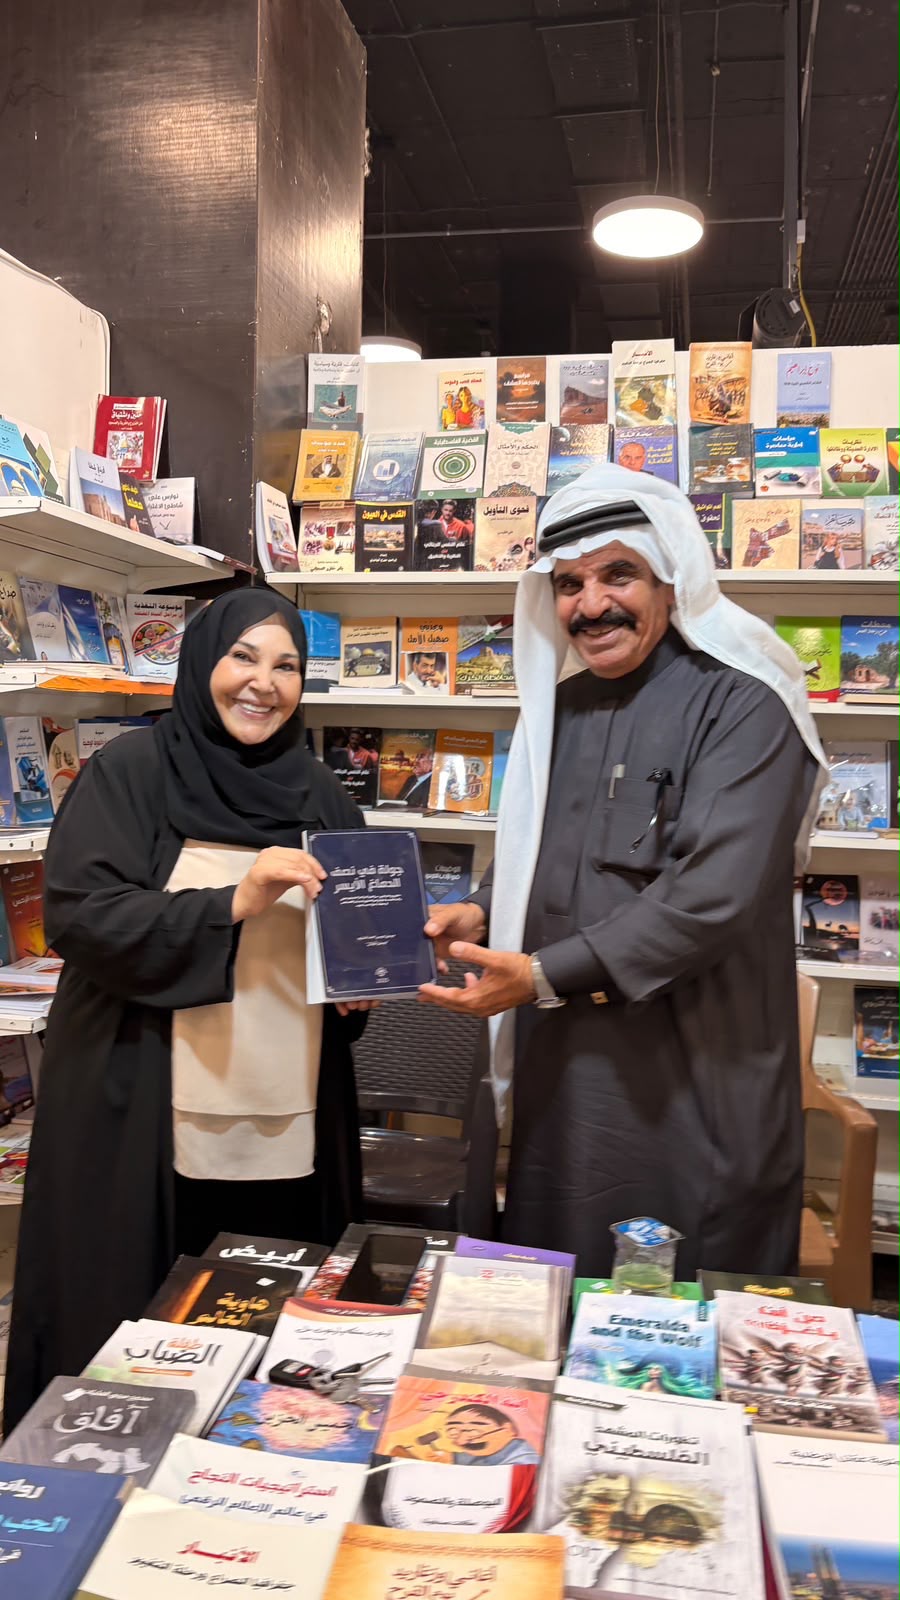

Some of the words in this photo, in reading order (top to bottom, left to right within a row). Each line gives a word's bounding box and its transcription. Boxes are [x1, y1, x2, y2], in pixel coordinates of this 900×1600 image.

[162, 493, 179, 501] نوارس
[362, 510, 379, 519] العيون
[388, 510, 407, 519] القدس
[484, 505, 508, 516] التأويل
[510, 505, 529, 514] فحوى
[134, 601, 157, 610] التغذية
[330, 865, 356, 877] نصف
[357, 866, 377, 880] في
[378, 865, 405, 877] جولة
[333, 878, 366, 894] الأيسر
[368, 879, 402, 892] الدماغ
[216, 1291, 271, 1313] هاوية
[186, 1310, 253, 1326] العالم
[609, 1314, 690, 1333] Emeralda
[589, 1325, 622, 1338] and
[626, 1328, 657, 1342] the
[660, 1332, 704, 1348] Wolf
[124, 1339, 224, 1366] الضباب
[594, 1425, 649, 1440] المشهد
[650, 1430, 700, 1445] تطورات
[583, 1440, 711, 1466] الفلسطيني
[187, 1467, 241, 1484] النجاح
[239, 1477, 338, 1498] استراتيجيات
[178, 1493, 229, 1509] الرقمي
[223, 1499, 273, 1513] الإعلام
[268, 1505, 304, 1519] عالم
[303, 1510, 329, 1525] في
